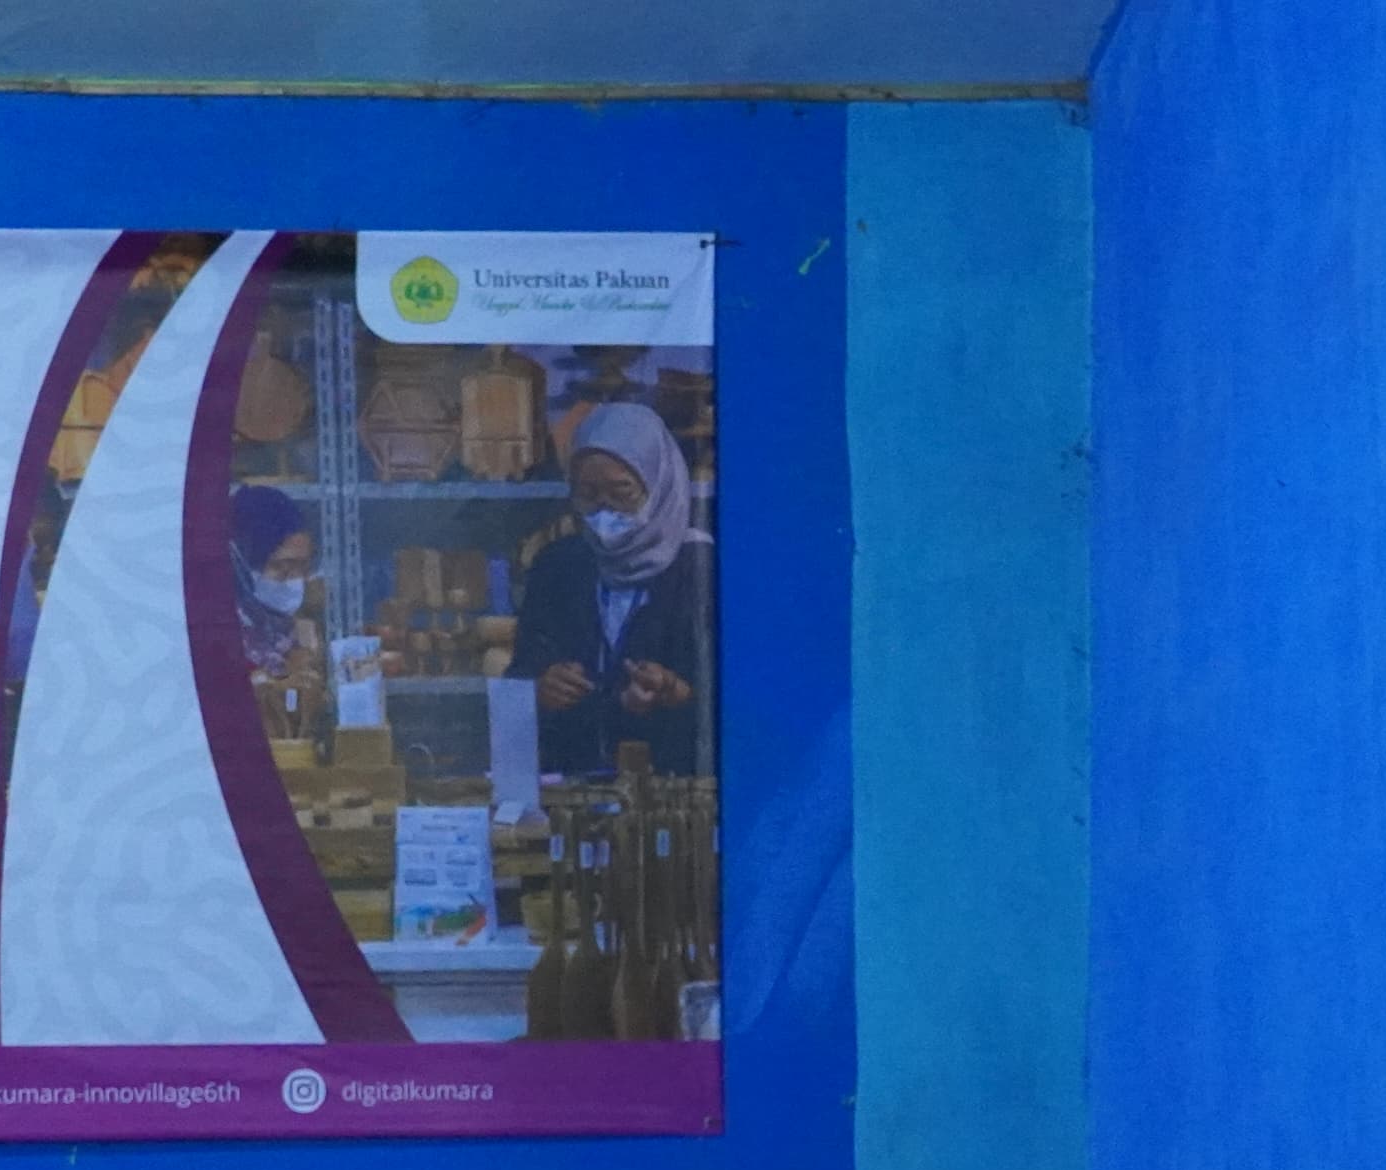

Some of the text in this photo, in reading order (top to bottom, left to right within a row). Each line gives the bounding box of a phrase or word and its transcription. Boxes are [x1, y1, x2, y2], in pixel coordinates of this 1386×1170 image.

[473, 268, 670, 289] Universitas Pakuan
[341, 1078, 494, 1108] digitalkumara
